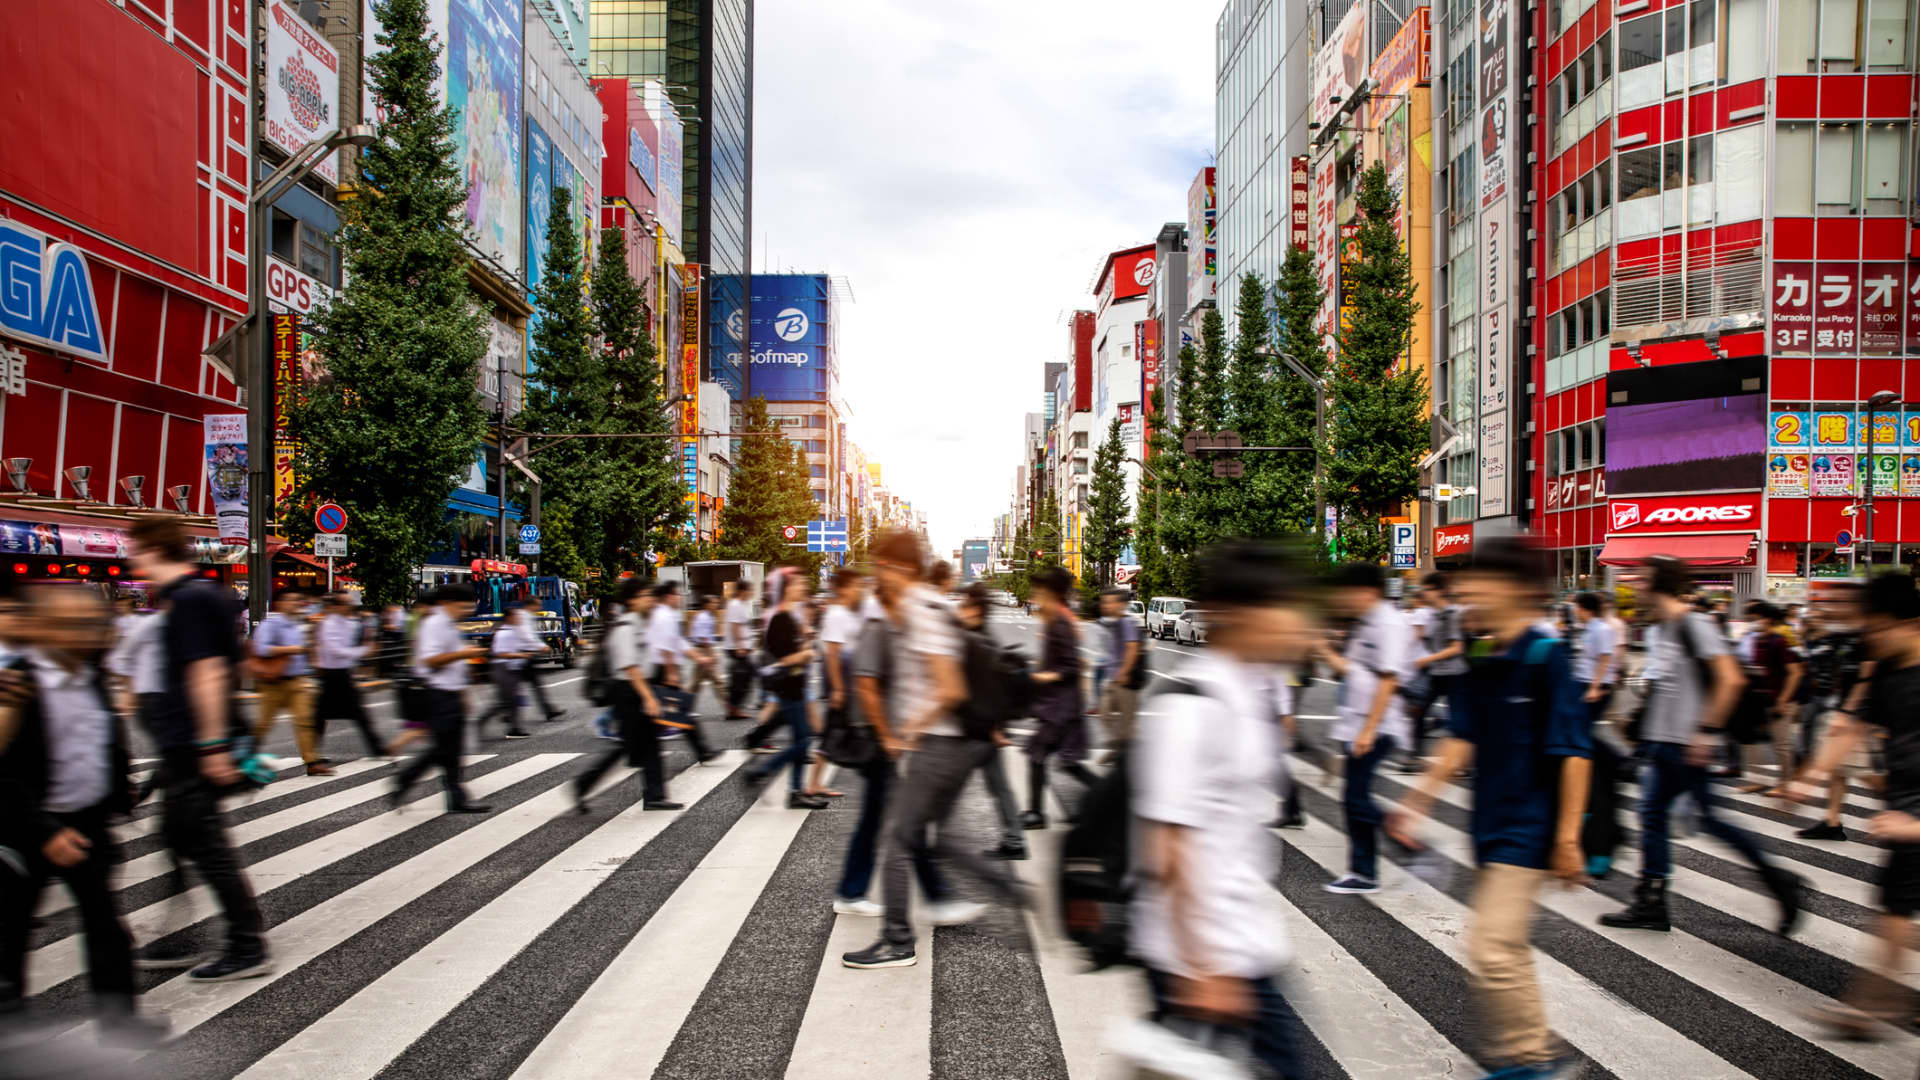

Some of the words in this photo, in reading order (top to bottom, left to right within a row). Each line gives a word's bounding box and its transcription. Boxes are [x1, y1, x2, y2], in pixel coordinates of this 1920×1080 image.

[279, 67, 296, 95] BIG
[299, 86, 330, 124] APPLE
[269, 120, 287, 145] BIG
[1489, 221, 1499, 303] Anime
[268, 263, 311, 310] GPS
[1773, 313, 1812, 322] Karaoke
[1832, 315, 1854, 324] Party
[1882, 313, 1897, 322] OK
[1776, 329, 1808, 346] 3F
[1816, 329, 1855, 347] 受付
[1489, 311, 1499, 388] Plaza
[1644, 505, 1753, 523] ADORES
[1398, 528, 1412, 544] P
[1395, 555, 1406, 564] IN
